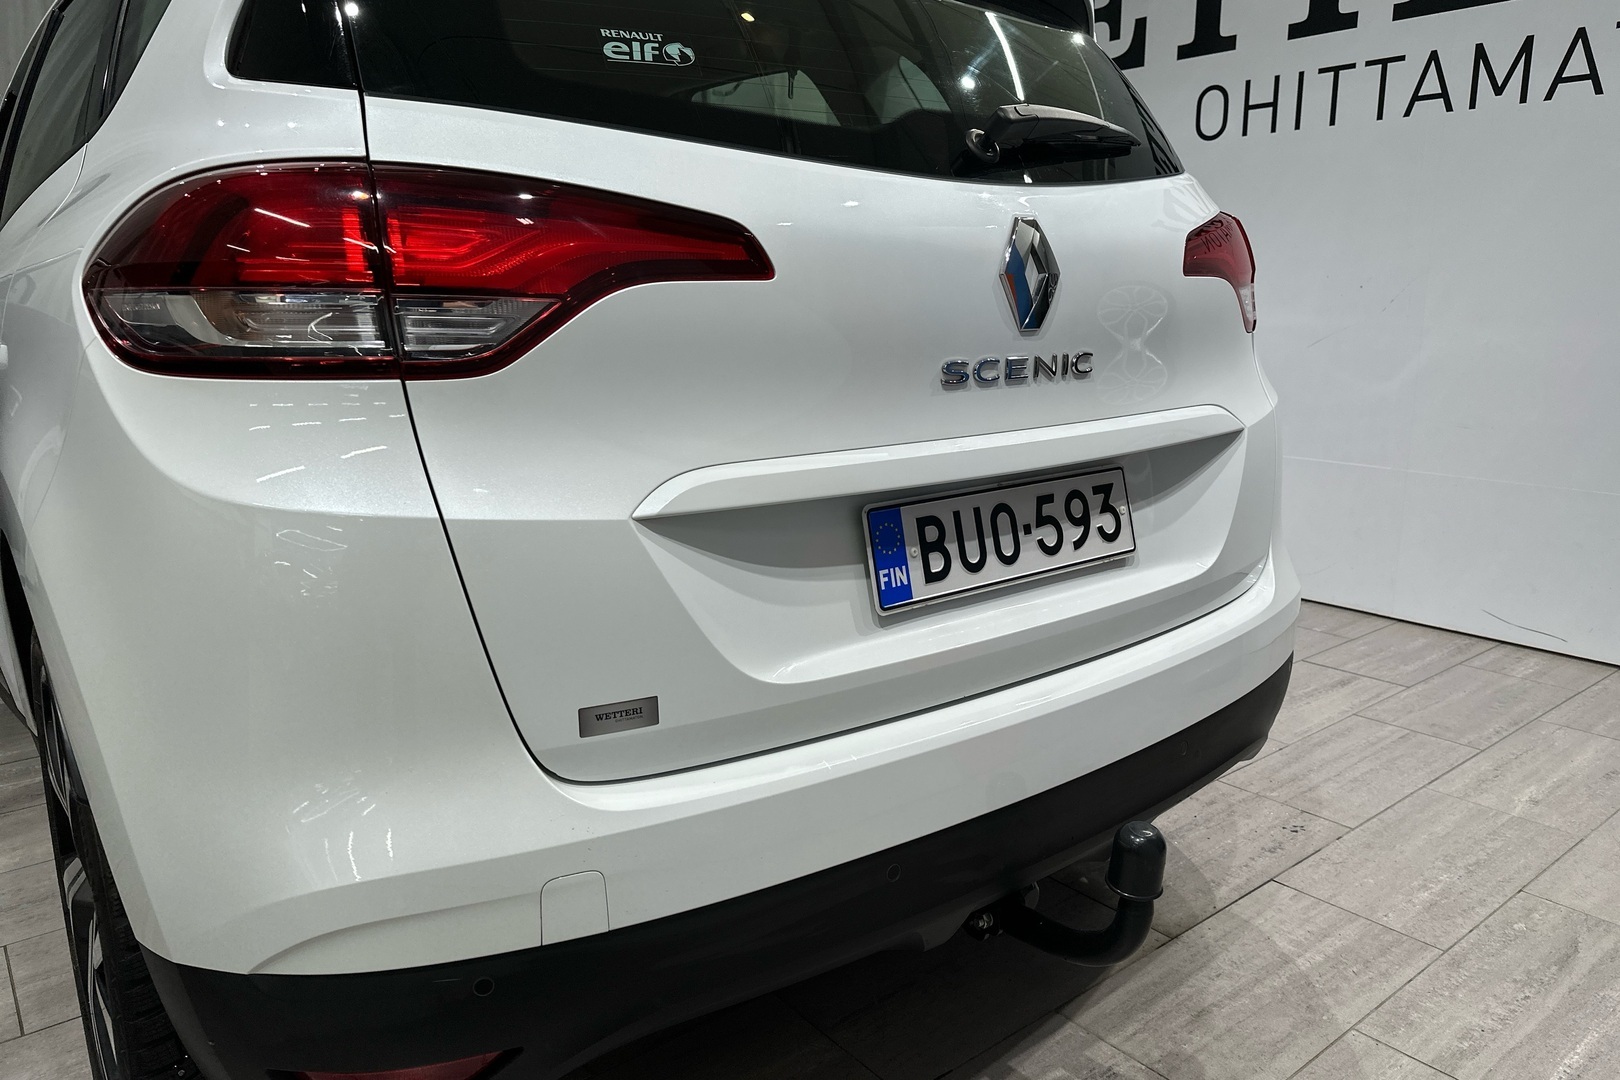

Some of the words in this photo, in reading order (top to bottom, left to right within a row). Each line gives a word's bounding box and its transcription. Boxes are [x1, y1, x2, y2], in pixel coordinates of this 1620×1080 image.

[600, 28, 663, 42] RENAULT
[603, 41, 660, 62] elf
[1194, 21, 1620, 142] OHITTAMA
[940, 351, 1094, 386] SCENIC
[878, 565, 908, 590] FIN
[594, 706, 644, 722] WETTERI
